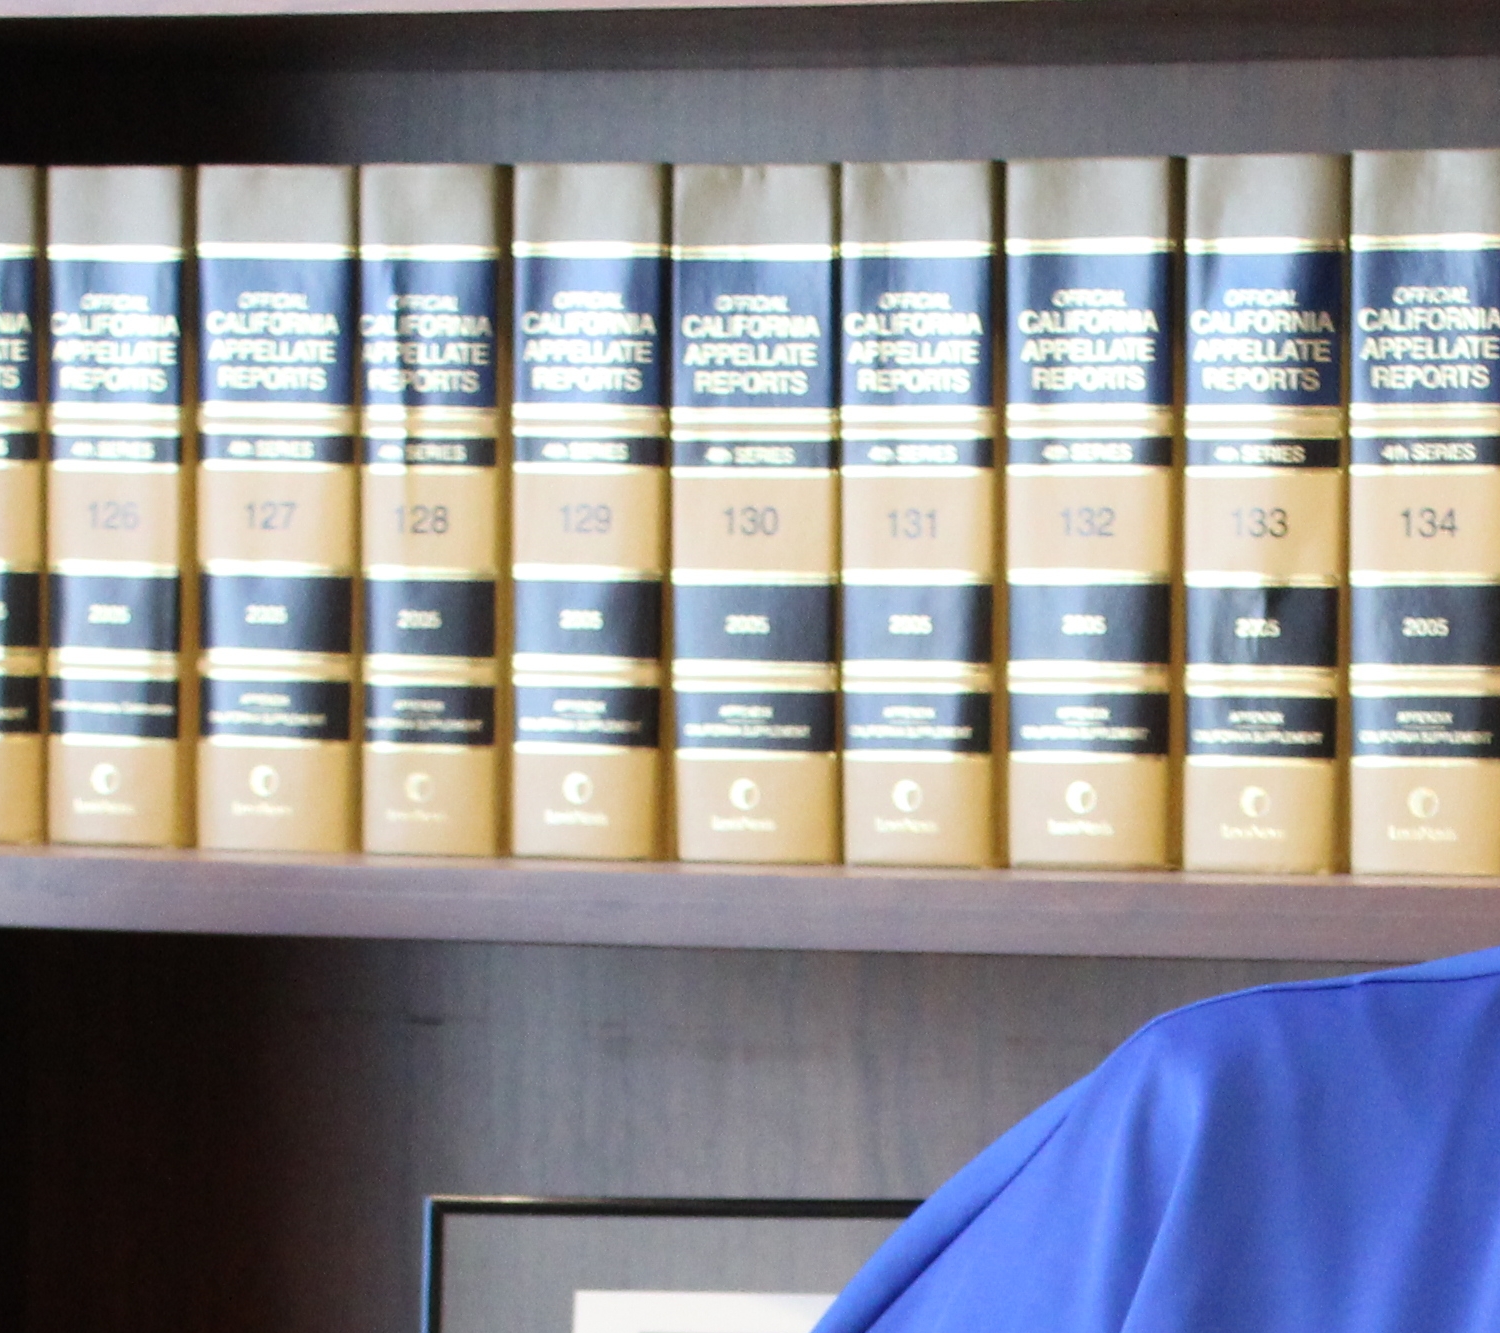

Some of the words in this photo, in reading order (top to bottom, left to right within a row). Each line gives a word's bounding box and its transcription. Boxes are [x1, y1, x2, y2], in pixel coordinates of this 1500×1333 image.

[207, 312, 339, 338] CALIFORNIA
[682, 313, 819, 339] CALIFORNIA
[844, 311, 982, 337] CALIFORNIA
[1019, 308, 1159, 334] CALIFORNIA
[1190, 308, 1334, 335] CALIFORNIA
[209, 339, 336, 366] APPELLATE
[684, 341, 817, 368] APPELLATE
[847, 339, 979, 366] APPELLATE
[1020, 336, 1155, 363] APPELLATE
[1192, 337, 1330, 364] APPELLATE
[1359, 335, 1499, 361] APPELLATE
[217, 366, 326, 393] REPORTS
[694, 370, 808, 397] REPORTS
[856, 369, 970, 395] REPORTS
[1031, 366, 1146, 393] REPORTS
[1201, 367, 1321, 393] REPORTS
[1370, 363, 1490, 389] REPORTS
[88, 501, 139, 531] 126
[245, 502, 297, 531] 127
[396, 504, 449, 534] 128
[559, 505, 612, 534] 129
[723, 506, 780, 537] 130
[888, 507, 939, 538] 131
[1060, 507, 1115, 538] 132
[1232, 508, 1289, 538] 133
[1400, 507, 1459, 538] 134
